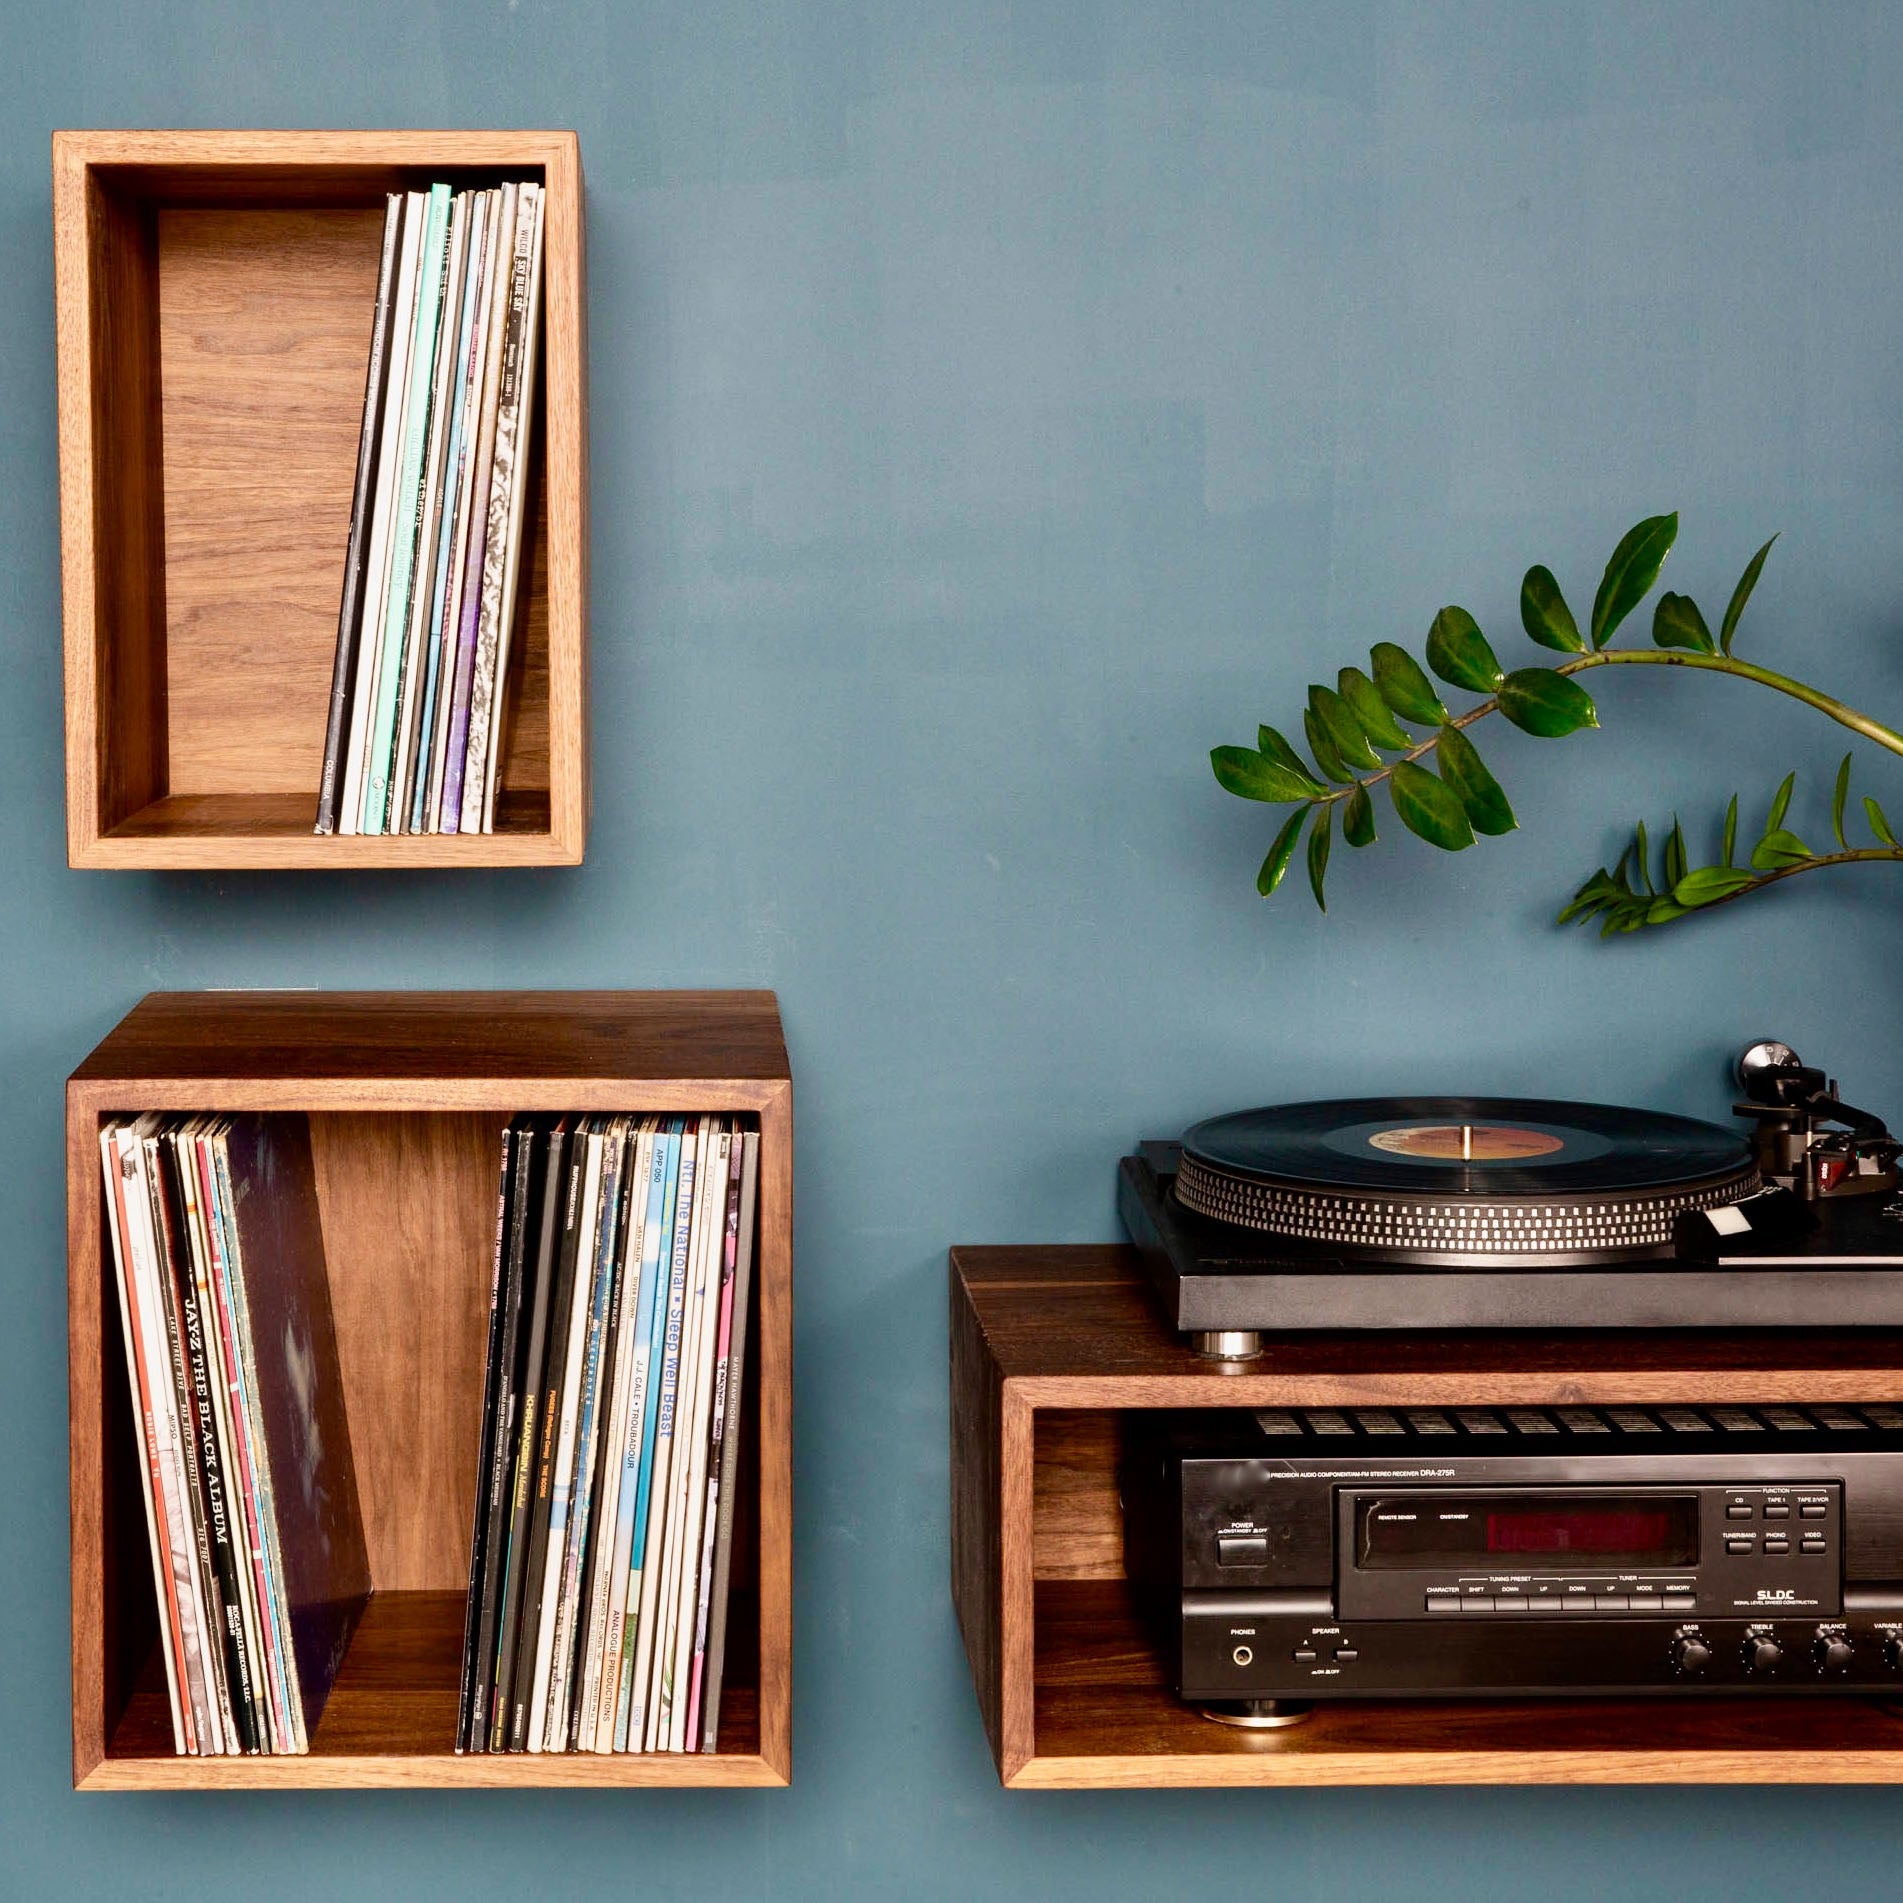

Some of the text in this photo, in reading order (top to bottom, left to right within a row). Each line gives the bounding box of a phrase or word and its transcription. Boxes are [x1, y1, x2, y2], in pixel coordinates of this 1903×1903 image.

[520, 229, 529, 254] WILCO
[513, 259, 526, 313] SKY BLUE SKY
[323, 760, 335, 799] COLUMBIA
[653, 1148, 664, 1183] APP 050
[497, 1195, 506, 1218] ASTRAL
[496, 1219, 504, 1240] WEEKS
[493, 1257, 501, 1290] MORRISON
[631, 1276, 639, 1296] DIVER
[629, 1297, 637, 1319] DOWN
[660, 1160, 696, 1438] Ntl. The National Sleep Well Beast
[169, 1316, 185, 1390] LAKE STREET DIVE
[731, 1356, 739, 1381] MAYER
[547, 1390, 557, 1414] FUGEES
[627, 1360, 644, 1469] J.J. CALE TROUBADOUR
[728, 1382, 738, 1430] HAWTHORNE
[169, 1414, 178, 1439] MIPSO
[183, 1298, 228, 1544] JAY-Z THE BLACK ALBUM
[520, 1394, 535, 1472] KHRUANGBIN
[181, 1403, 198, 1487] BAD SELF PORTRAITS
[497, 1427, 505, 1457] VANGUARD
[726, 1437, 735, 1461] WHERE
[541, 1464, 549, 1476] THE
[724, 1463, 733, 1483] DOES
[1420, 1469, 1455, 1477] DRA-275R
[540, 1477, 548, 1499] SCORE
[720, 1527, 729, 1540] GO
[603, 1609, 620, 1722] ANALOGUE PRODUCTIONS
